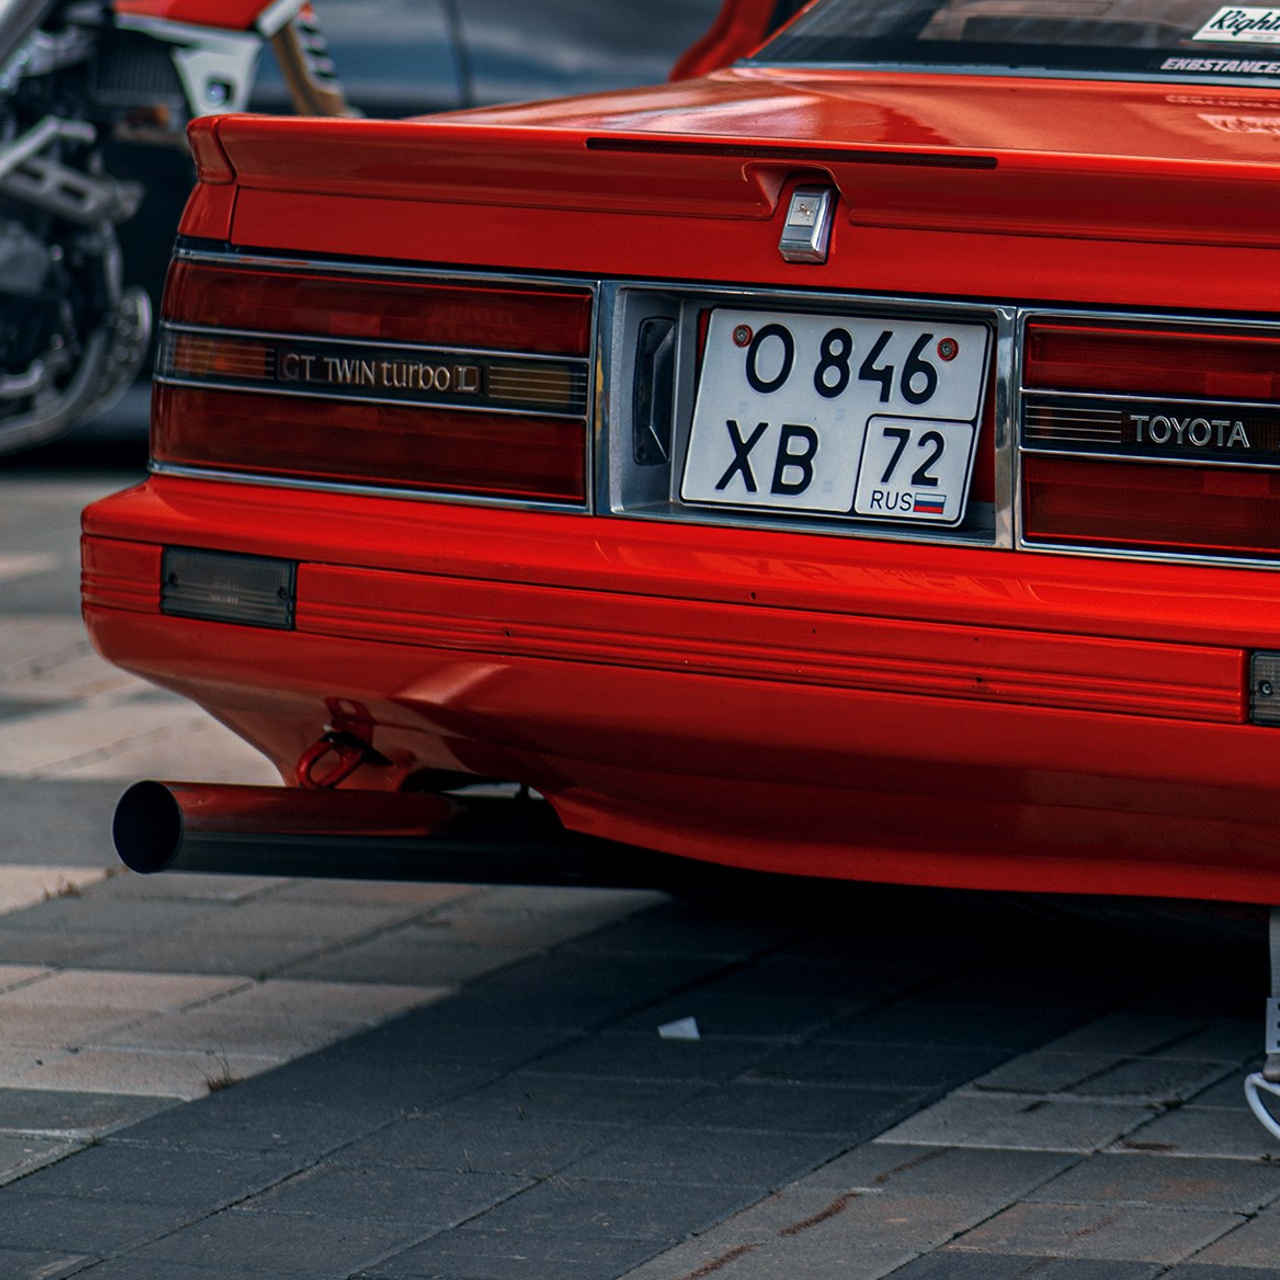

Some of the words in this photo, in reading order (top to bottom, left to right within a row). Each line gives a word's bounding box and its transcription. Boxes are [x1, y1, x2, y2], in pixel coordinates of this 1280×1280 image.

[282, 352, 316, 382] GT
[323, 357, 376, 387] TWIN
[380, 360, 451, 392] turbo
[813, 327, 938, 405] 846
[1130, 414, 1250, 449] TOYOTA
[880, 427, 945, 487] 72
[869, 489, 913, 512] RUS
